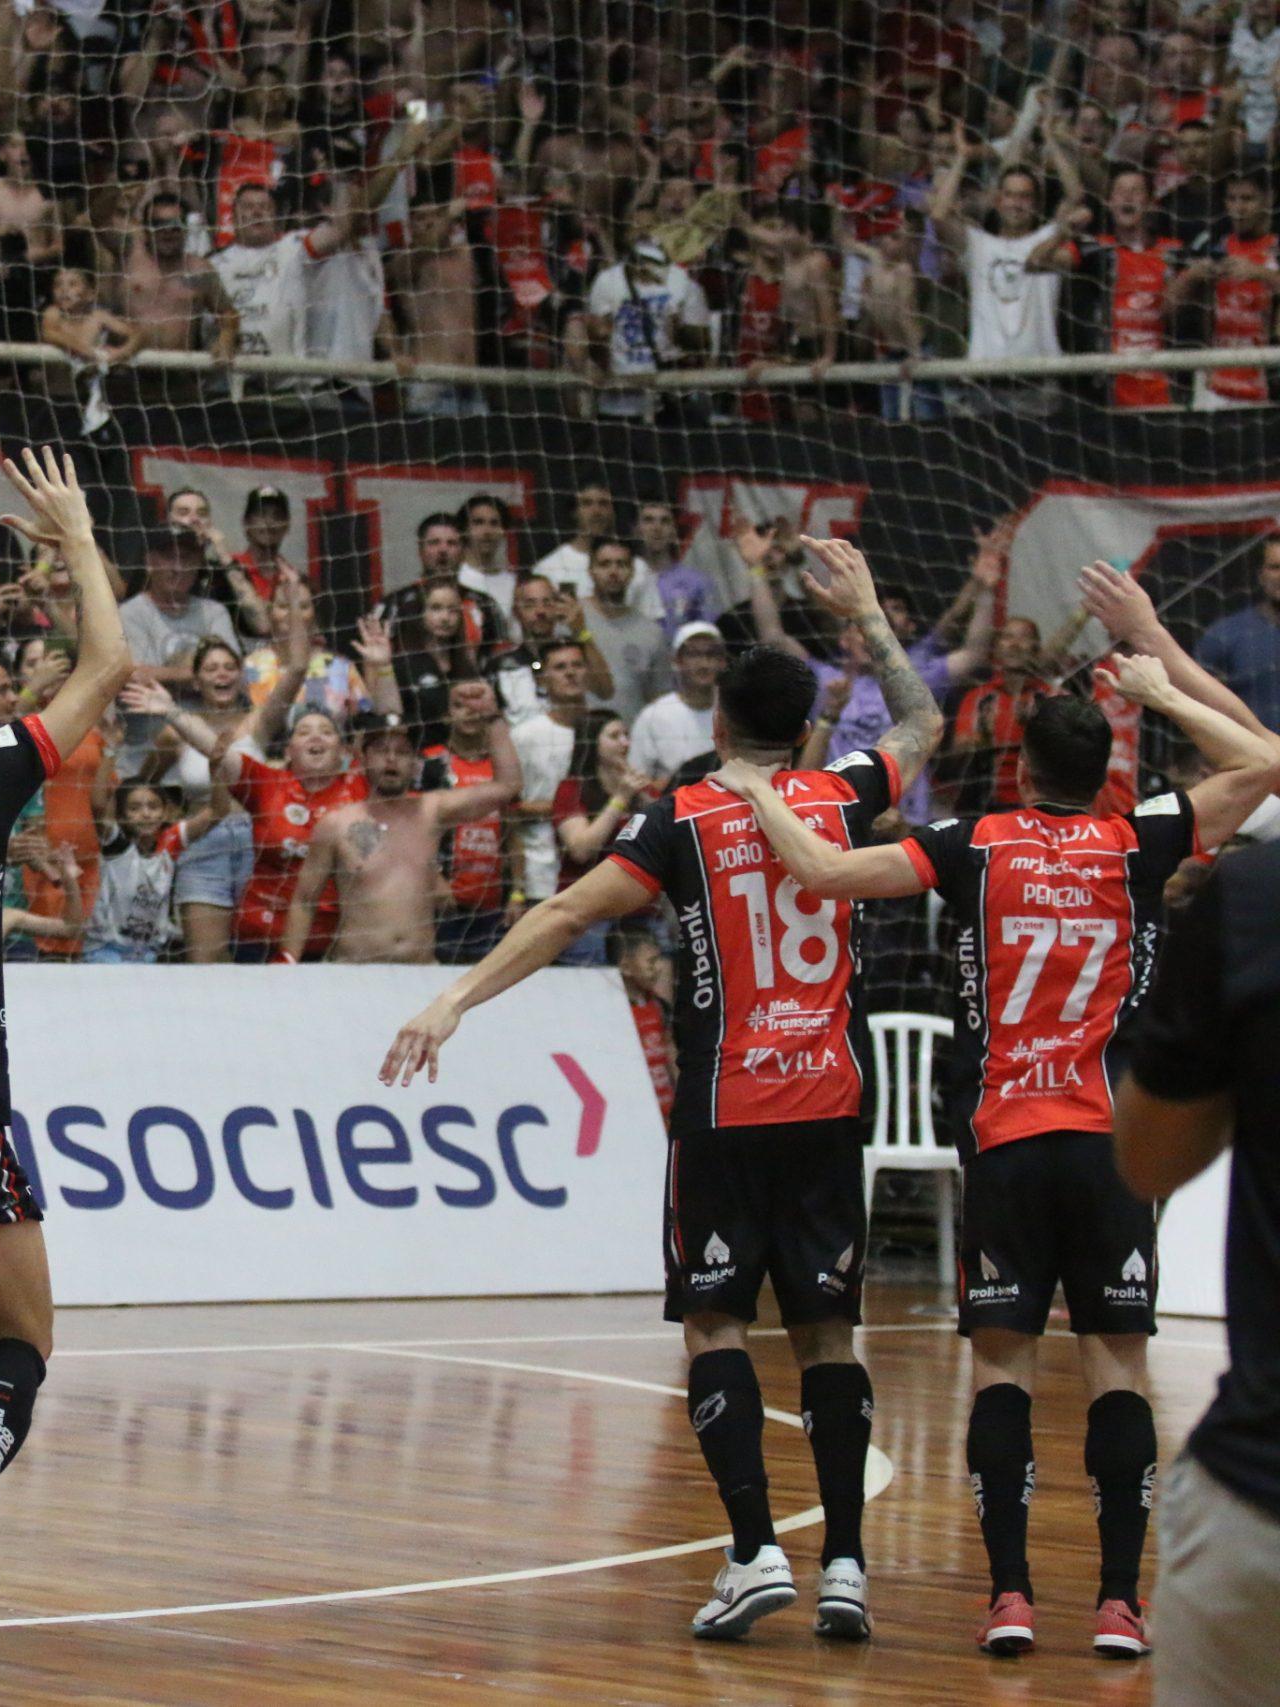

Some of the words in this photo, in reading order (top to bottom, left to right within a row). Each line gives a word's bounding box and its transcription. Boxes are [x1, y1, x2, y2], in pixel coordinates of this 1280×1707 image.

[713, 839, 763, 873] JOÃO
[729, 871, 839, 990] 18
[1000, 917, 1117, 1024] 77
[768, 998, 800, 1014] Mais
[775, 1048, 839, 1077] VILA
